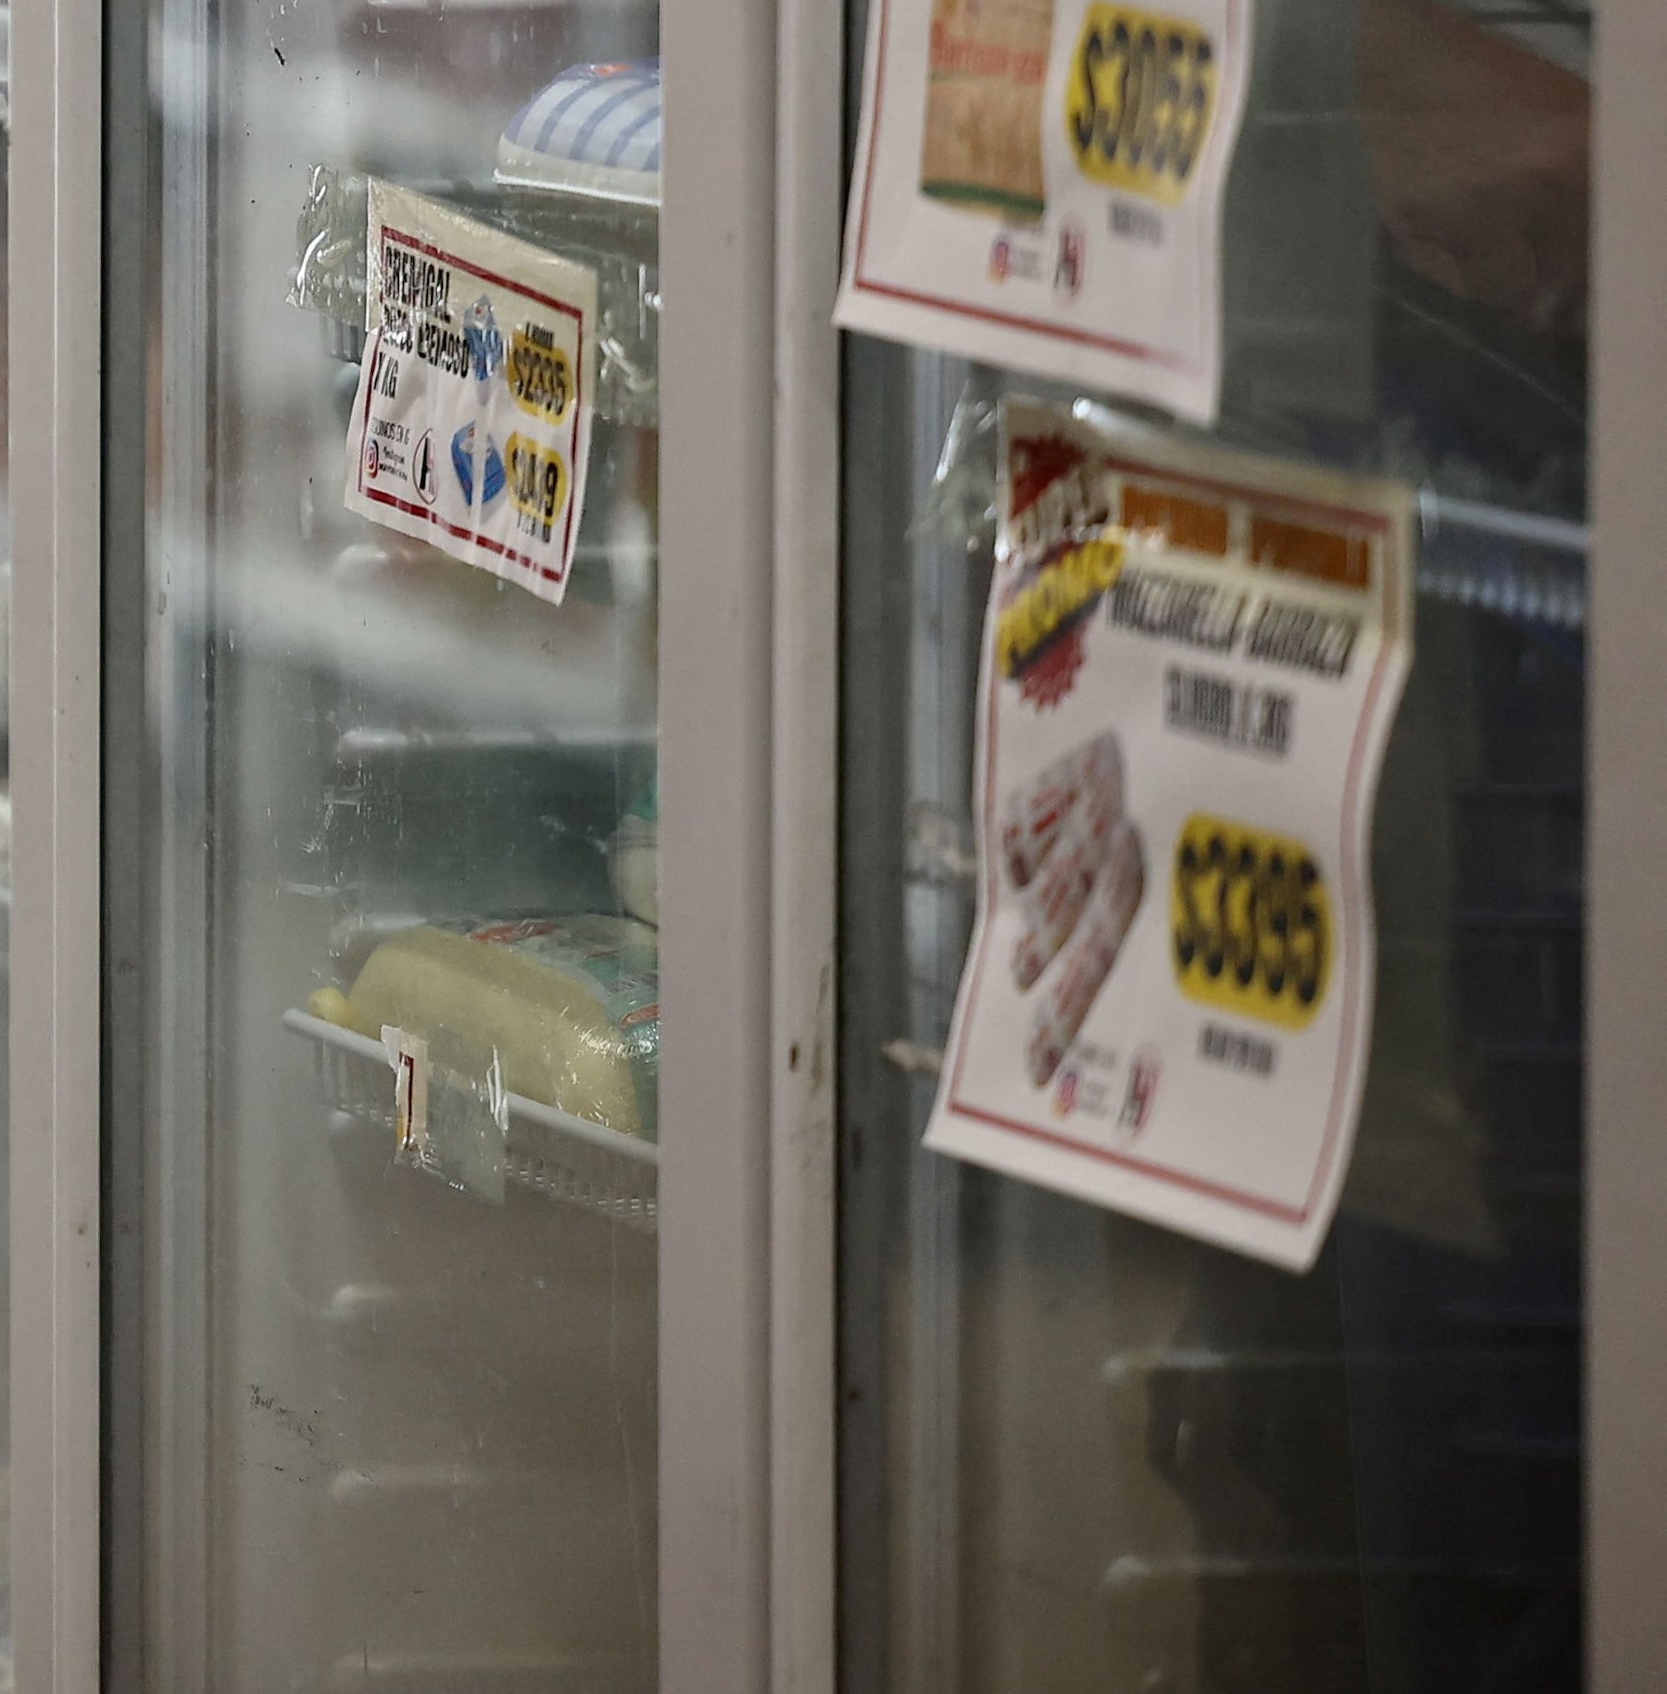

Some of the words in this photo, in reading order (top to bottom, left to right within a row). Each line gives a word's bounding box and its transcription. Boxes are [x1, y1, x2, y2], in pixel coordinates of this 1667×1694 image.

[1071, 18, 1213, 184] $3055
[384, 246, 451, 324] CREMIGAL
[381, 357, 398, 398] KG
[1174, 831, 1325, 1008] $3395
